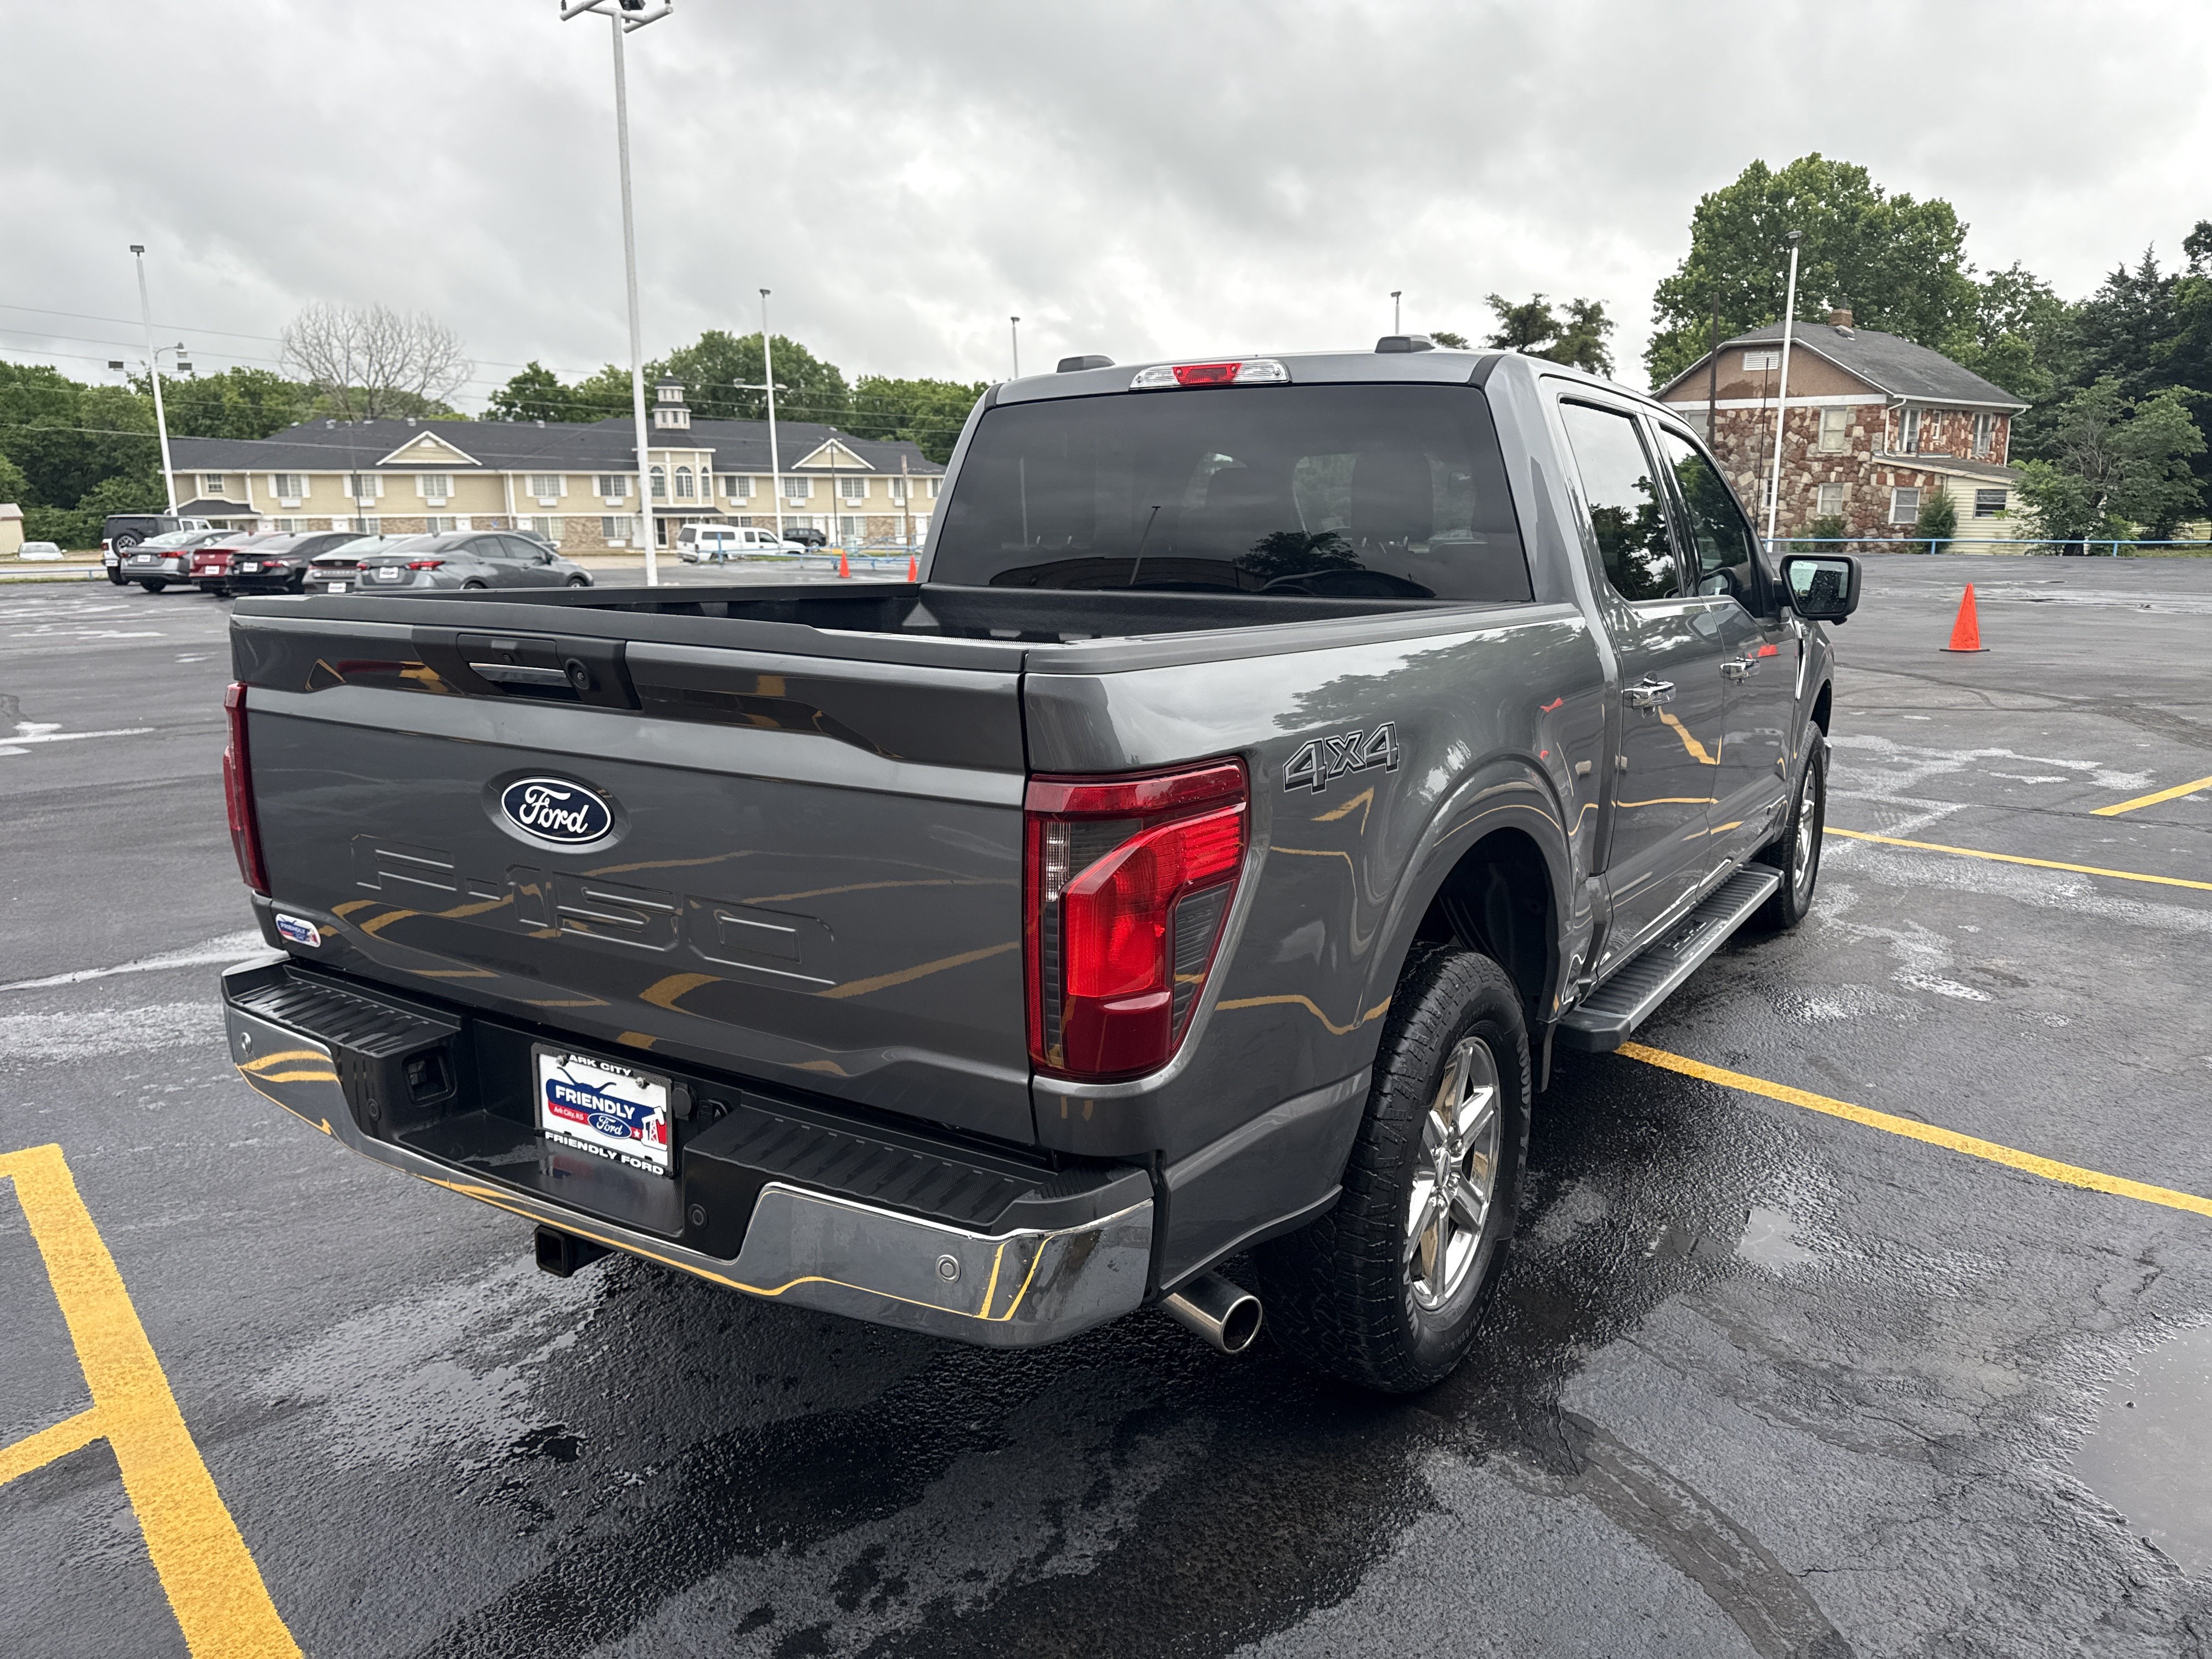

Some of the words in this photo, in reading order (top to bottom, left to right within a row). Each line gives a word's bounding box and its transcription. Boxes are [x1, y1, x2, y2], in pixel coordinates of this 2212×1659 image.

[519, 785, 589, 834] Ford
[350, 833, 837, 985] F-150
[569, 1054, 597, 1068] ARK
[600, 1062, 631, 1076] CITY
[554, 1106, 563, 1114] Ark
[555, 1085, 636, 1120] FRIENDLY
[596, 1115, 623, 1136] Ford
[545, 1131, 617, 1160] FRIENDLY
[621, 1154, 664, 1175] FORD
